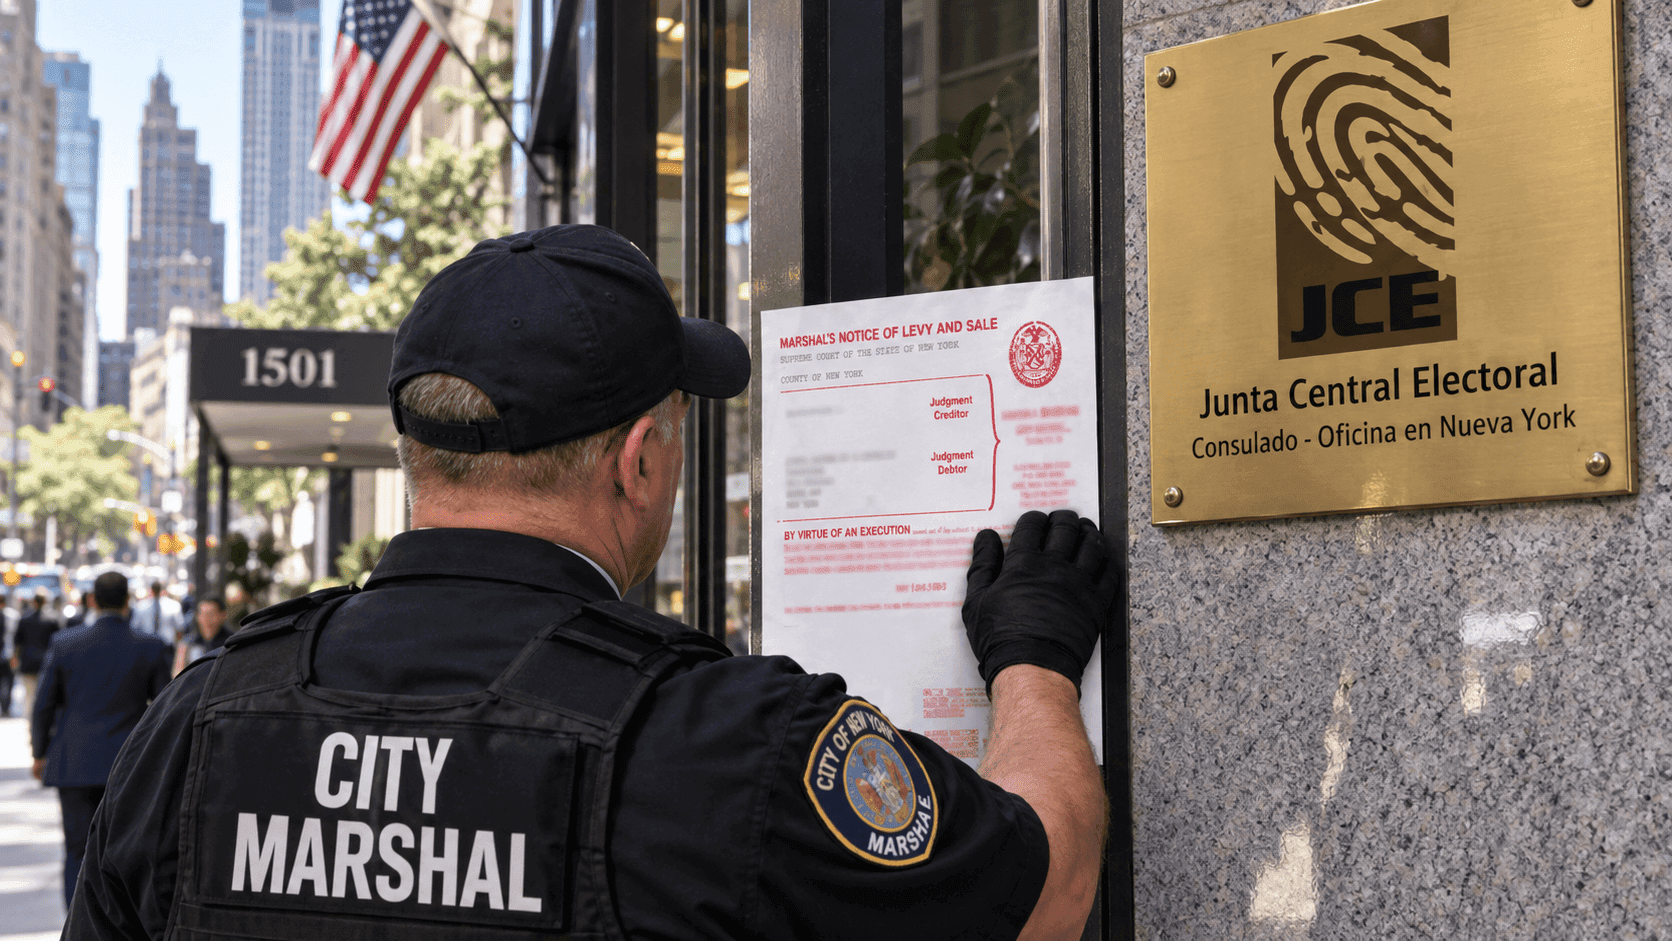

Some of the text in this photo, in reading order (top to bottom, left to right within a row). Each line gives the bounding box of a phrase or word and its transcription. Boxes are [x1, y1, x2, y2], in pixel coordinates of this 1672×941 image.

[1290, 270, 1441, 343] JCE
[779, 317, 998, 349] MARSHAL'S NOTICE OF LEVY AND SALE
[241, 347, 338, 388] 1501
[843, 350, 854, 359] OF
[857, 348, 872, 358] THE
[903, 344, 915, 353] OF
[780, 369, 863, 384] COUNTY OF NEW YORK
[1200, 352, 1558, 419] Junta Central Electoral
[929, 395, 973, 408] Judgment
[933, 409, 969, 420] Creditor
[1192, 430, 1298, 459] Consulado
[1318, 421, 1396, 449] Oficina
[1404, 422, 1431, 441] en
[1440, 414, 1513, 438] Nueva
[1521, 404, 1576, 431] York
[930, 450, 974, 463] Judgment
[938, 464, 968, 475] Debtor
[784, 530, 795, 541] BY
[798, 529, 828, 539] VIRTUE
[830, 528, 843, 538] OF
[844, 527, 858, 537] AN
[860, 525, 911, 536] EXECUTION
[816, 710, 895, 791] CITY OF NEW YORK
[314, 731, 453, 814] CITY
[231, 812, 543, 913] MARSHAL
